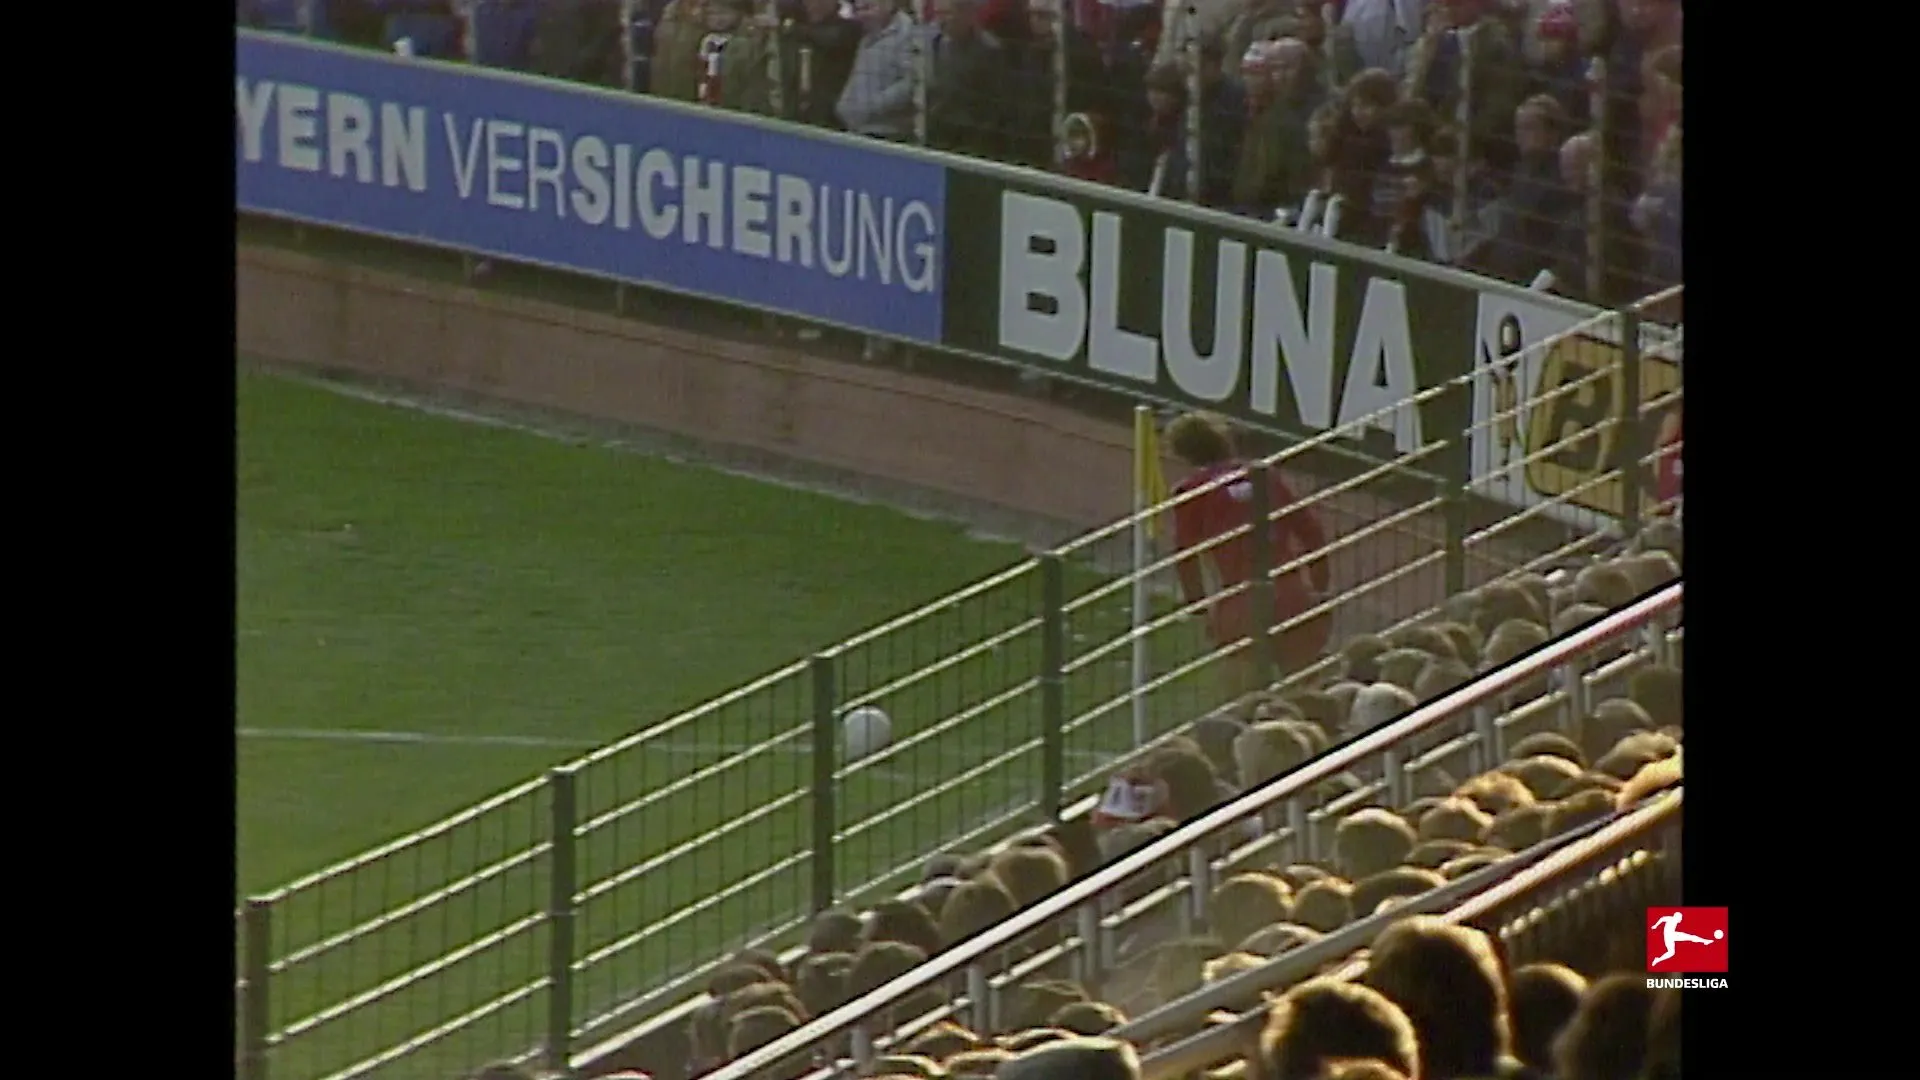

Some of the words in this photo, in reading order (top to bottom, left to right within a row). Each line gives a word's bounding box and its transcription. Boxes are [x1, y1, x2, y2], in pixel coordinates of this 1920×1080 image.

[236, 76, 426, 192] YERN
[444, 113, 936, 293] VERSICHERUNG
[1000, 191, 1421, 453] BLUNA
